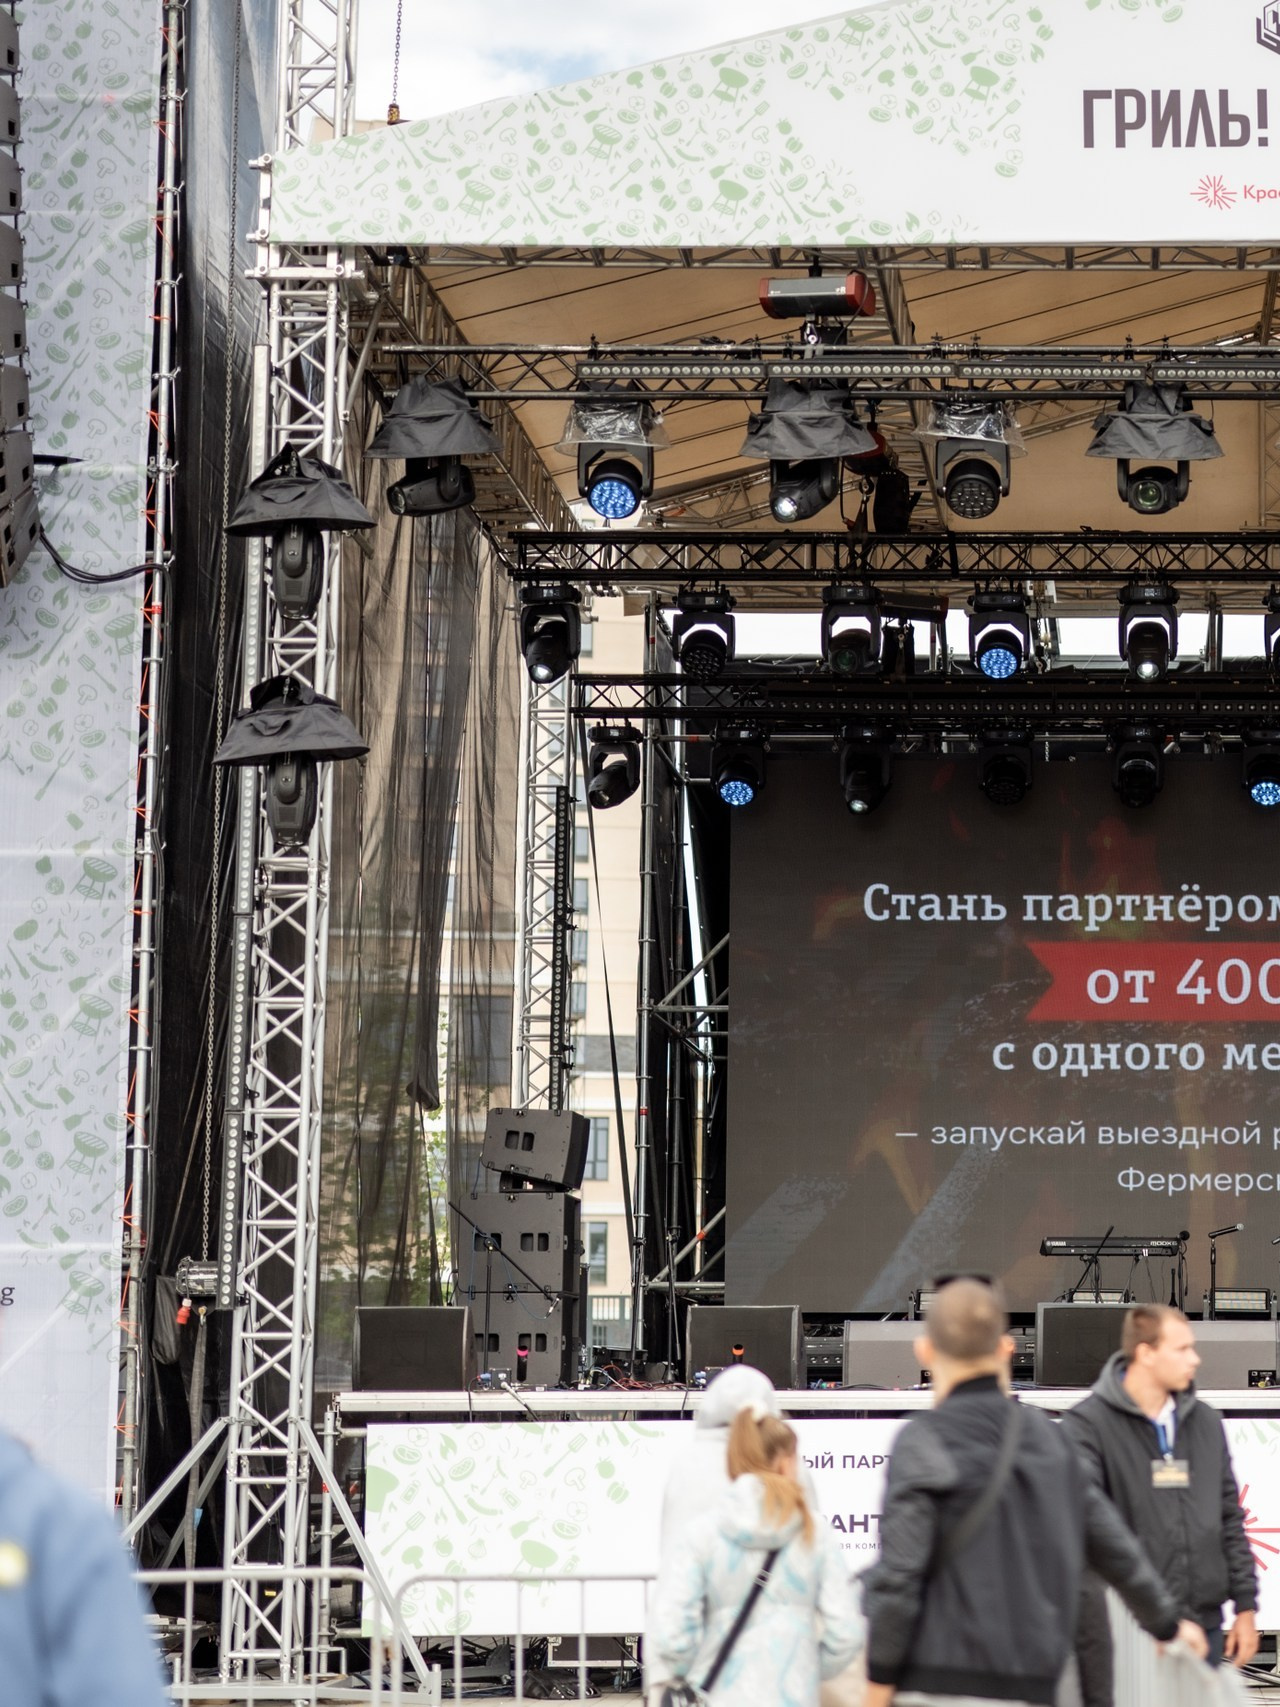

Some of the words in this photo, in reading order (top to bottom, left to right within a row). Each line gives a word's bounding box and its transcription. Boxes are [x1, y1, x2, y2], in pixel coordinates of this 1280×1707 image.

[1082, 88, 1270, 149] ГРИЛЬ!
[863, 883, 1007, 921] Стань
[1086, 969, 1155, 1004] от
[992, 1042, 1015, 1071] с
[1032, 1042, 1205, 1078] одного
[931, 1120, 1085, 1151] запускай
[1098, 1120, 1261, 1150] выездной
